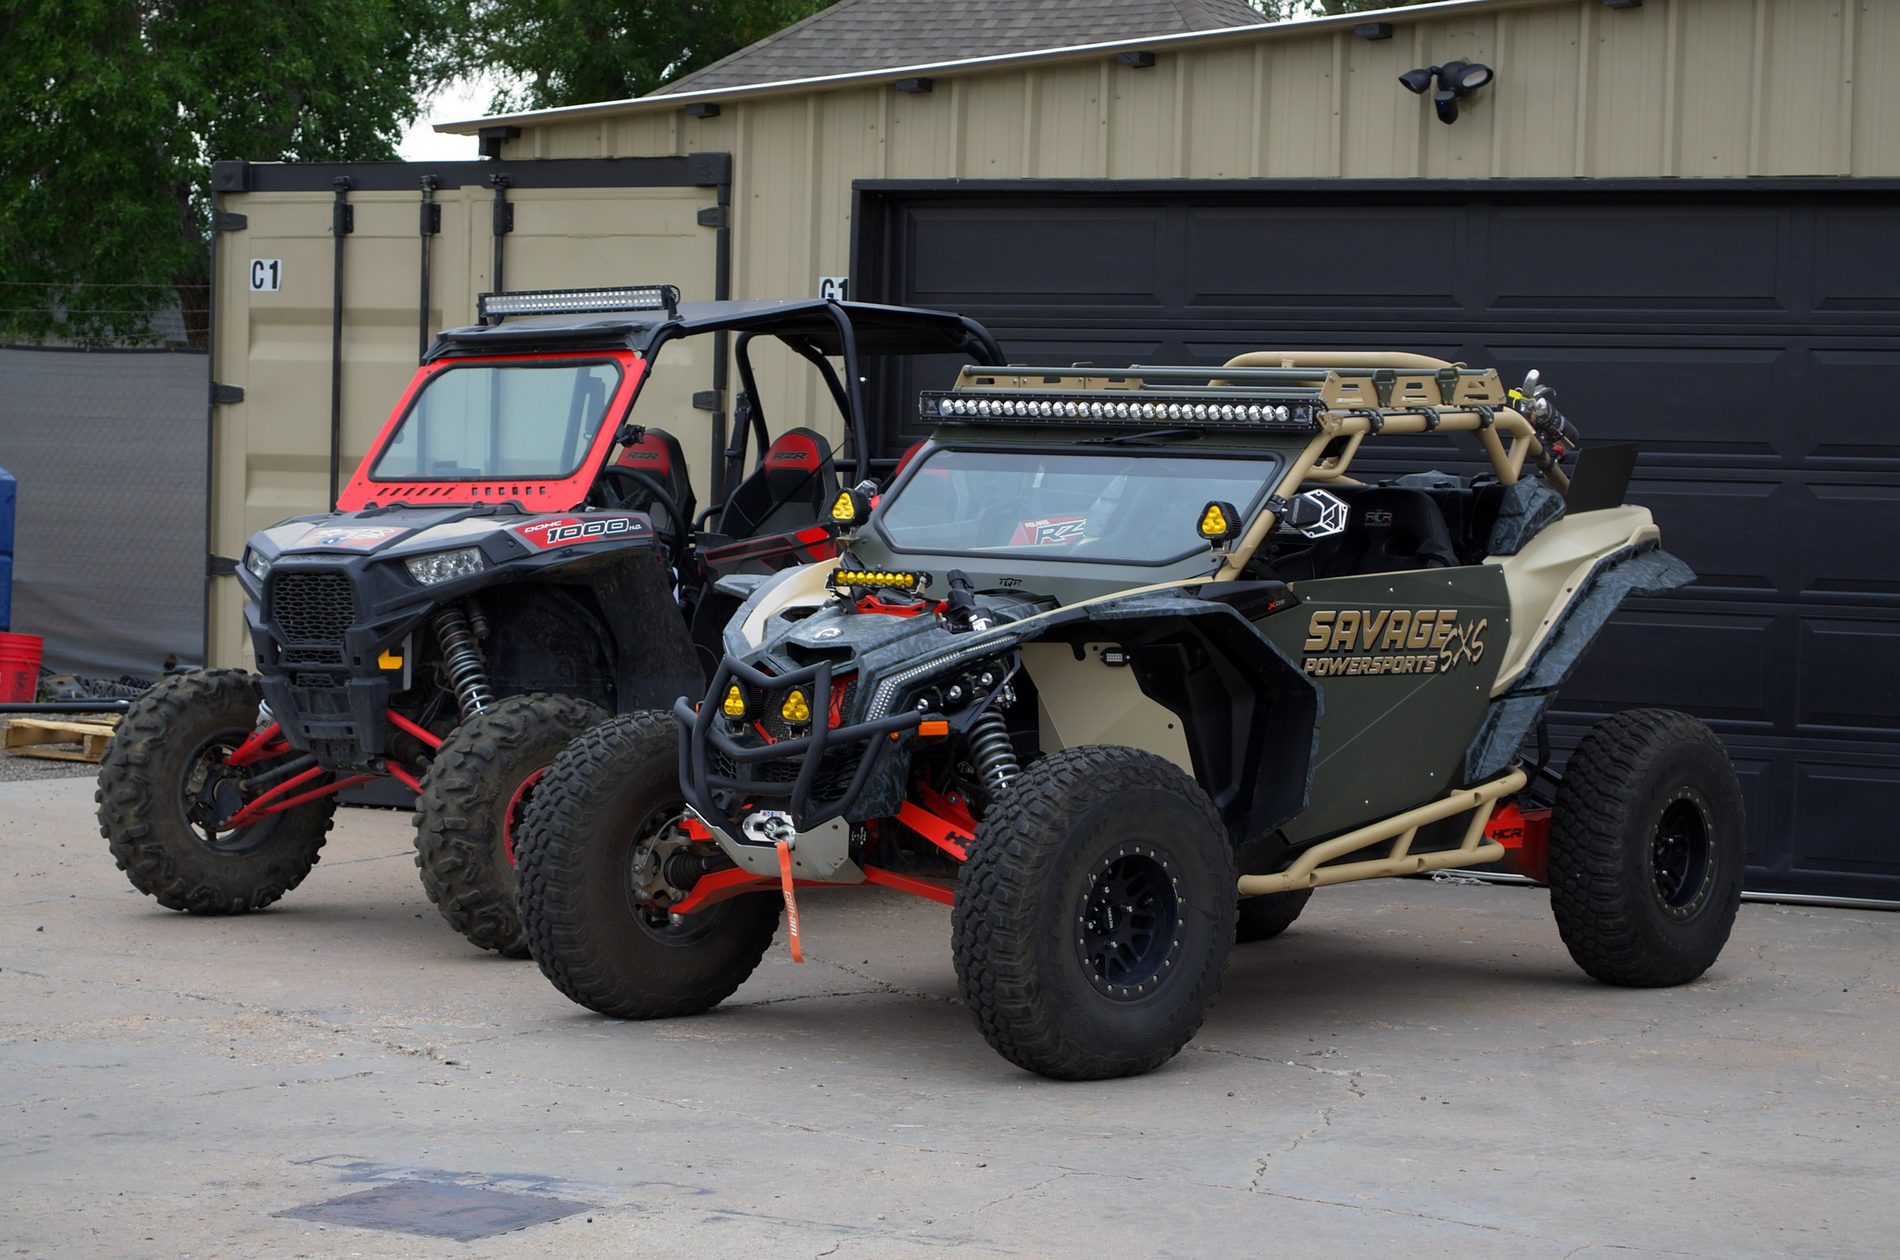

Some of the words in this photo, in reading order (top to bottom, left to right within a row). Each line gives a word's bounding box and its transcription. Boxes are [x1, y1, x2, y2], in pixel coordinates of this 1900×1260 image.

[252, 260, 278, 289] C1
[821, 278, 848, 301] G1
[772, 452, 808, 461] RZR
[524, 520, 562, 533] DOHC
[546, 518, 629, 544] 1000
[1034, 518, 1087, 544] RZ
[1303, 609, 1457, 650] SAVAGE
[1303, 655, 1438, 676] POWERSPORTS
